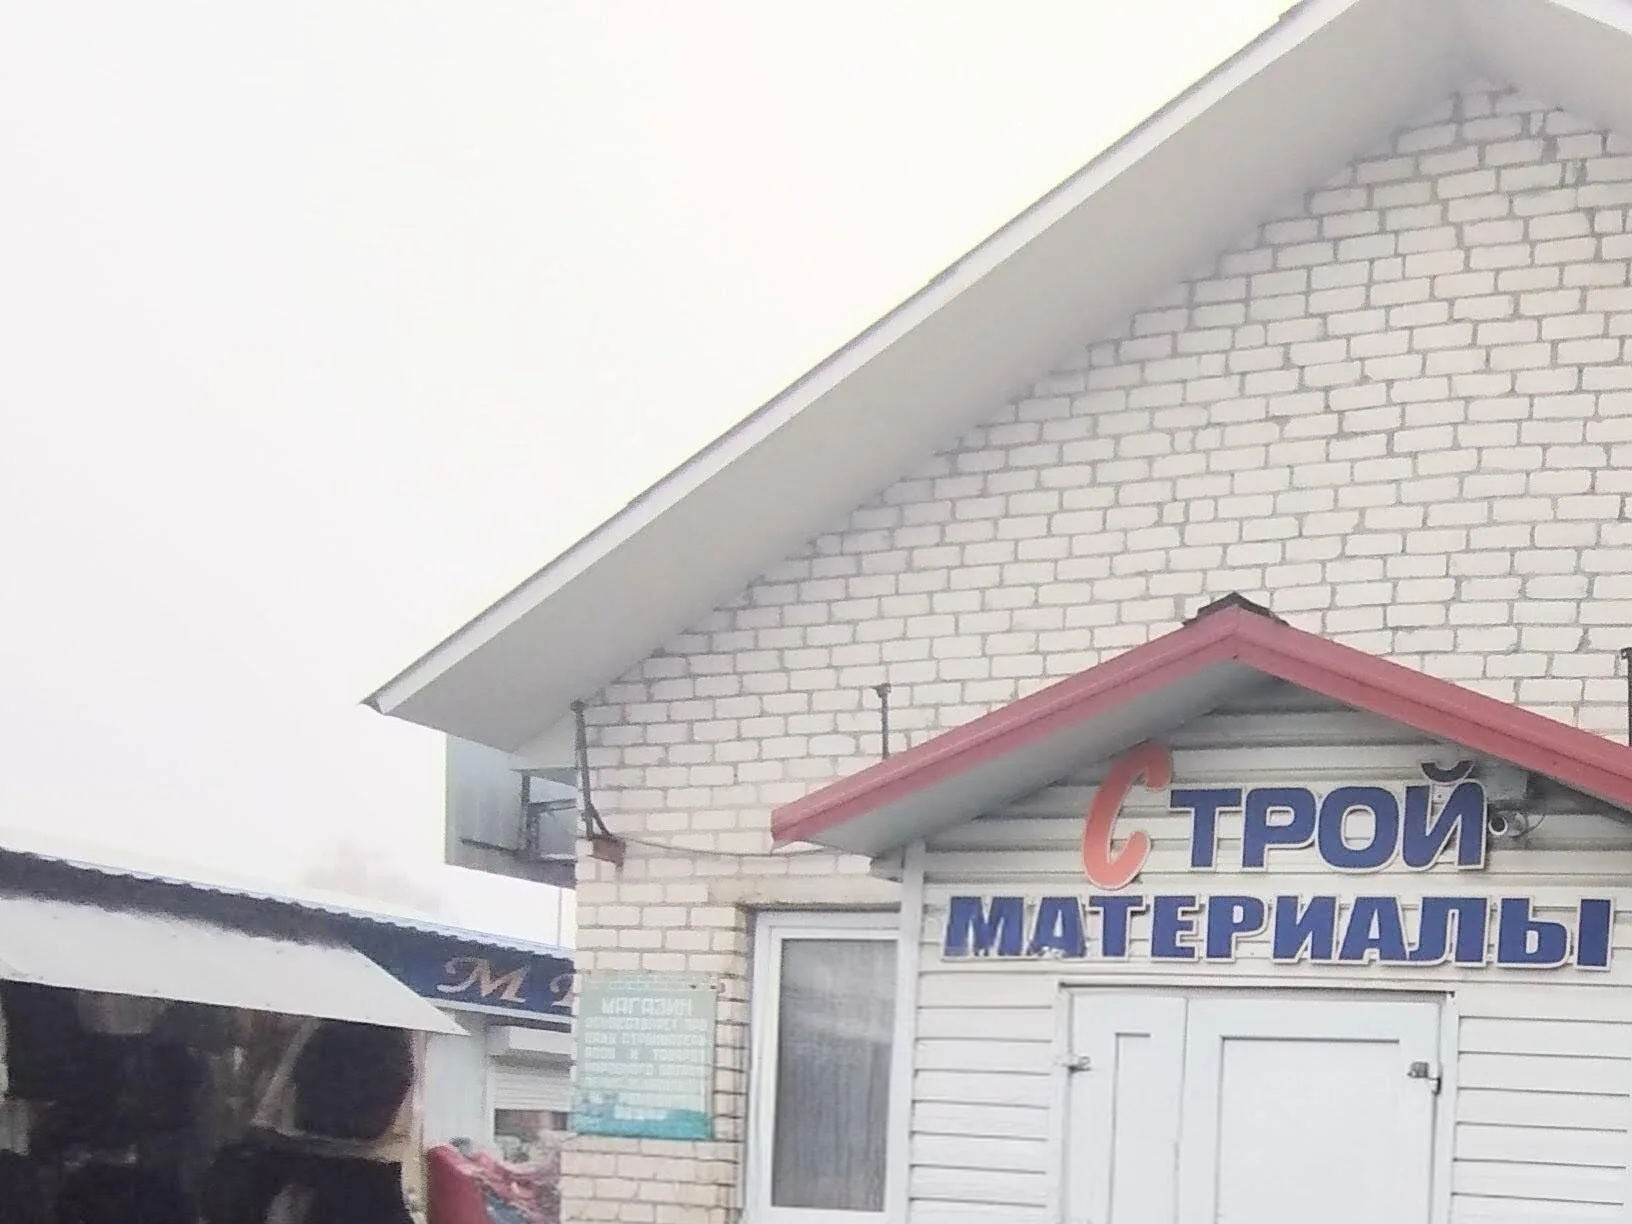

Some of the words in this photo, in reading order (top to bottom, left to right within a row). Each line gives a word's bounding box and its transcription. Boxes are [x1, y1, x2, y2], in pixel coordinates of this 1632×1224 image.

[1081, 741, 1487, 891] СТРОЙ
[940, 893, 1616, 971] МАТЕРИАЛЫ
[601, 997, 692, 1016] МАГАЗИН
